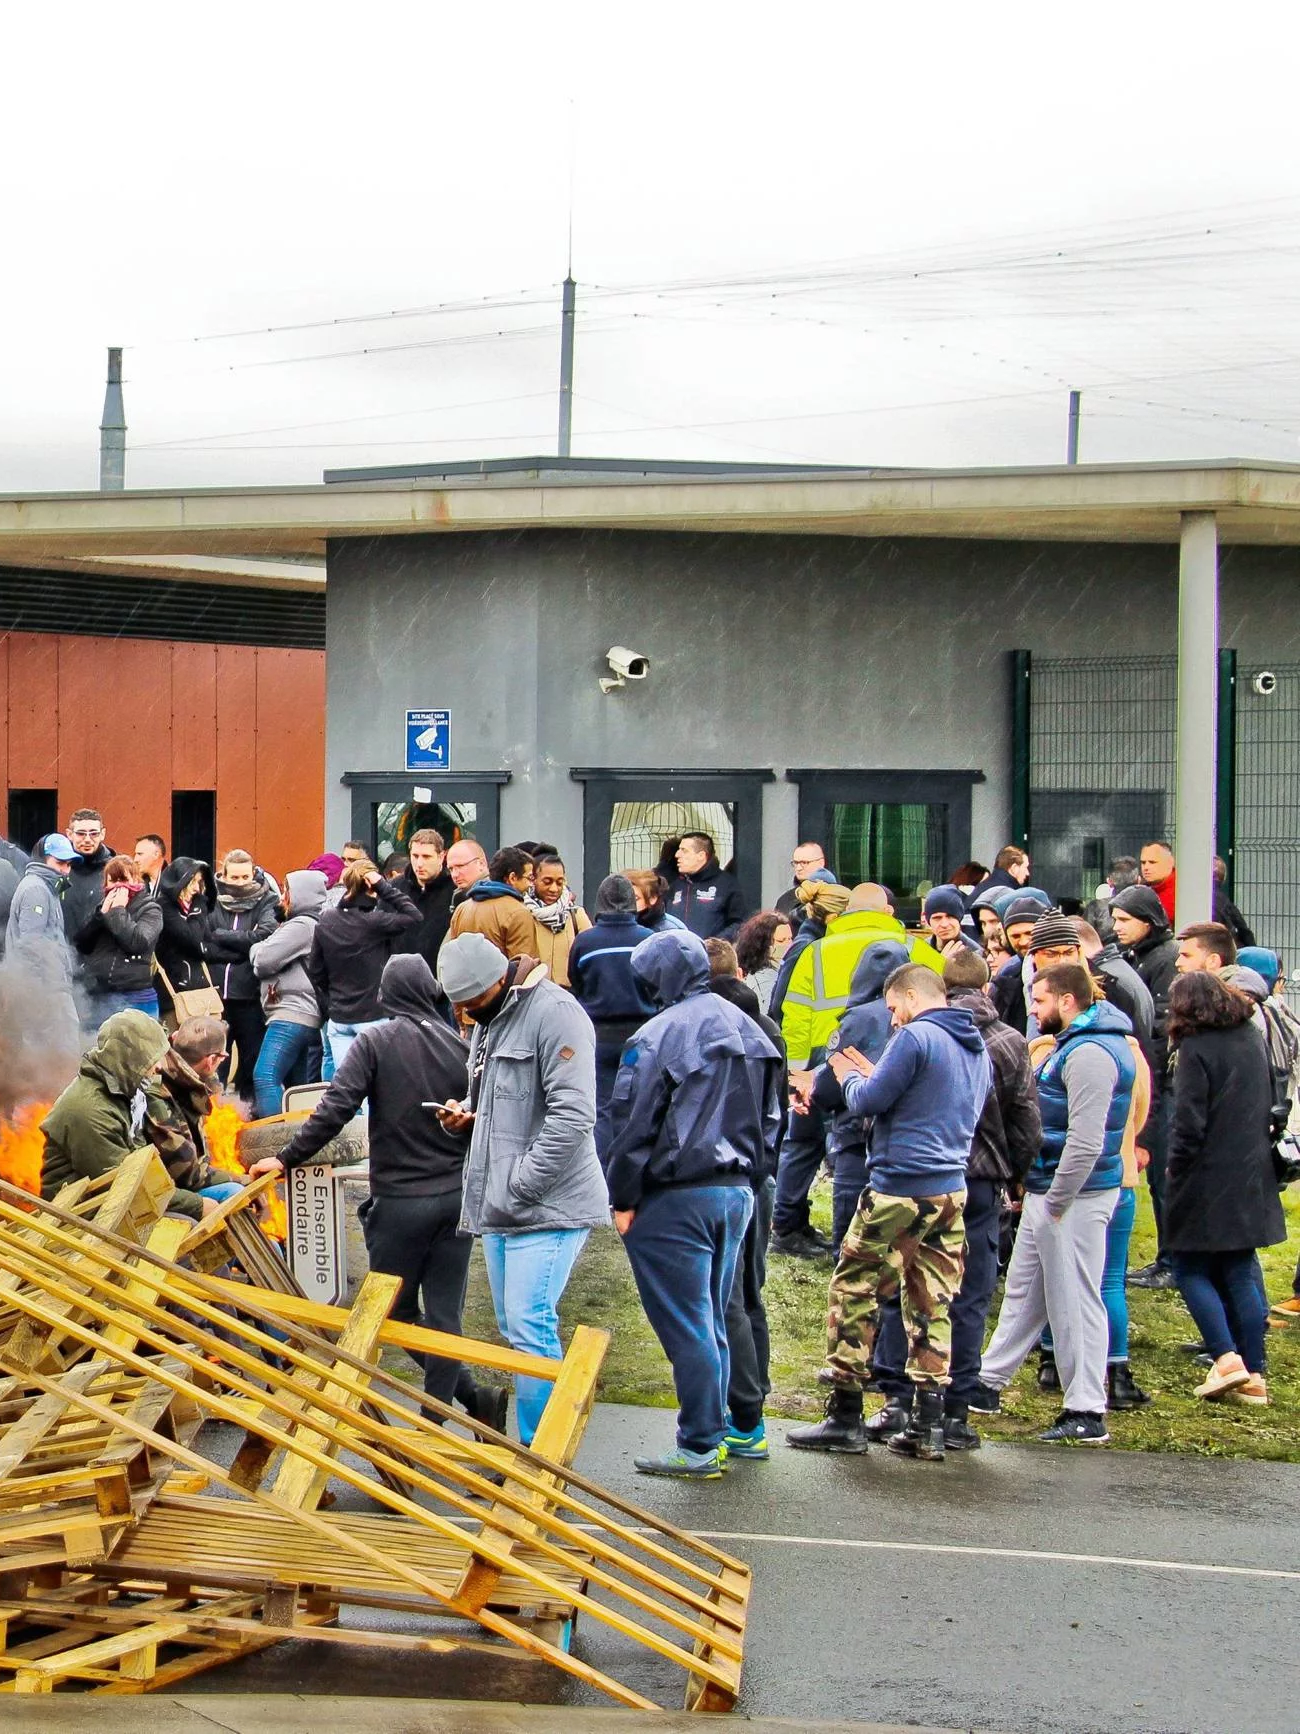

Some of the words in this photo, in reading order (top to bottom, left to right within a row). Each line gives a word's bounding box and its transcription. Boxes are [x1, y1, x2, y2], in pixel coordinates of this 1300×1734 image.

[295, 1168, 310, 1255] condaire
[313, 1167, 324, 1177] s
[314, 1185, 330, 1284] Ensemble
